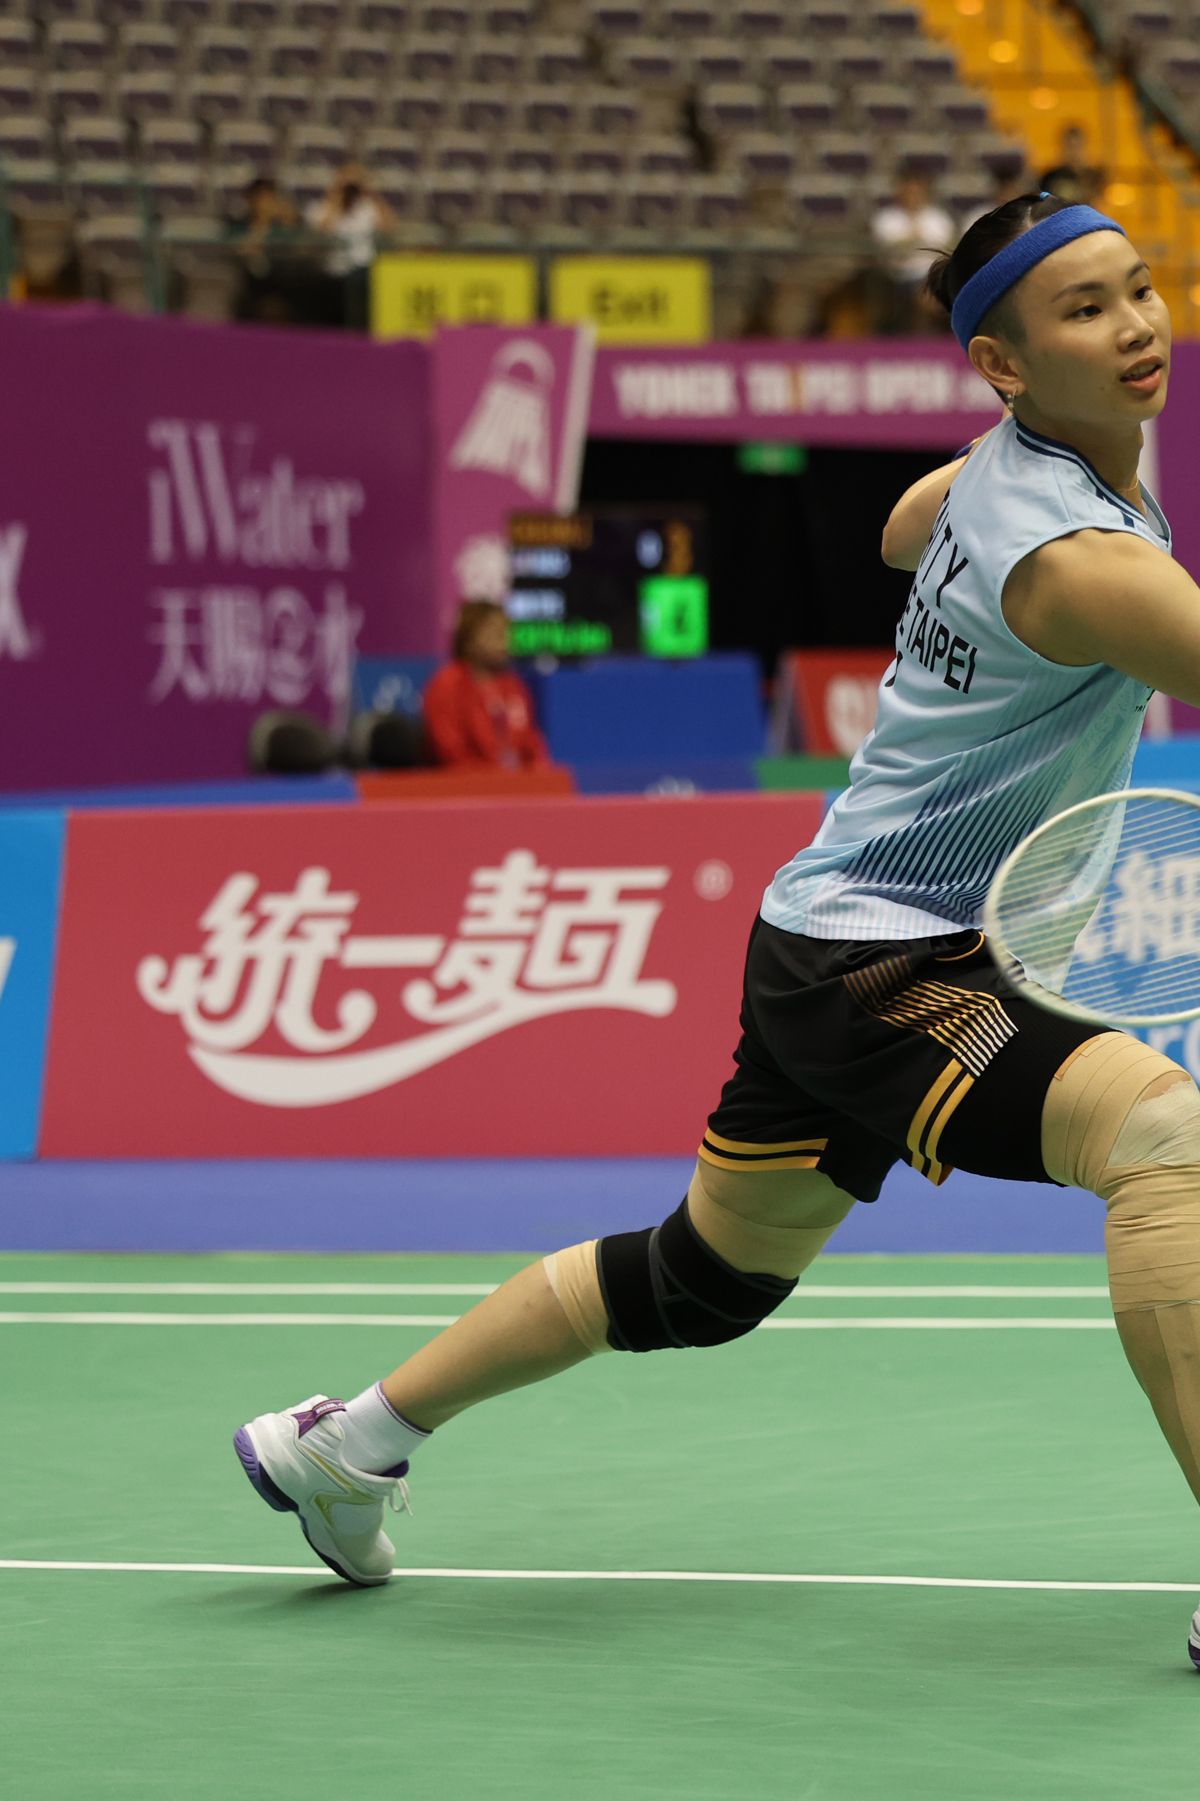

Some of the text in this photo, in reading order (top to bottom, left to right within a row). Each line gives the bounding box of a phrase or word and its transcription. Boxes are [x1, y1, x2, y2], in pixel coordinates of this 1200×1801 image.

[906, 596, 978, 694] TAIPEI
[137, 849, 678, 1106] 統一麵
